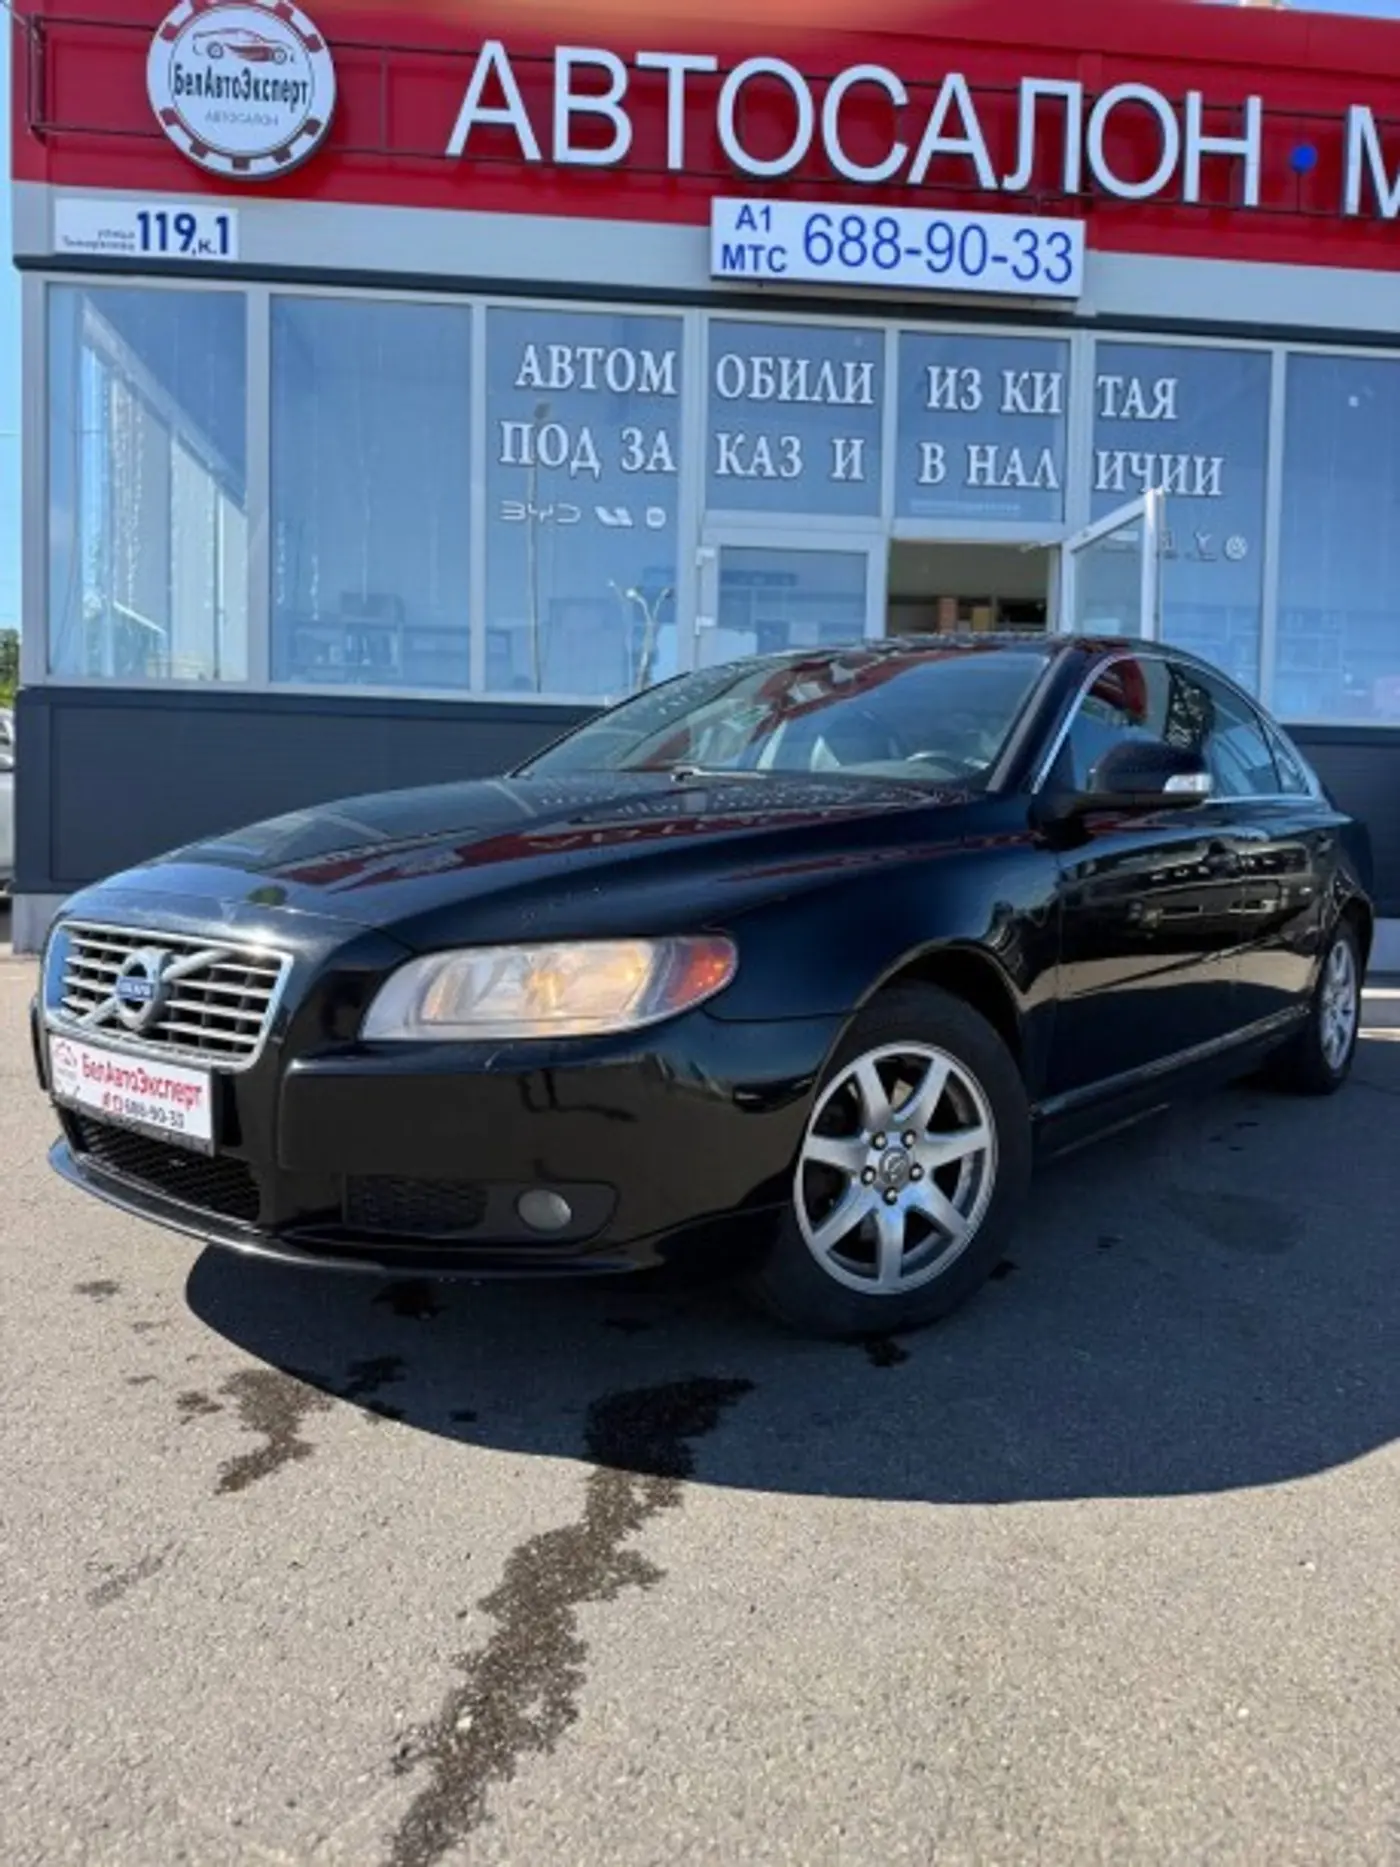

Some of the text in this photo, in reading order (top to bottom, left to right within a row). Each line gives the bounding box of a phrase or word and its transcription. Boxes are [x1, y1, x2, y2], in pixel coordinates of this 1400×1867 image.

[173, 63, 308, 113] БелАвтоЭксперт
[445, 40, 1262, 206] АВТОСАЛОН
[721, 244, 787, 273] МТС
[804, 213, 1073, 284] 688-90-33
[926, 365, 983, 411] ИЗ
[499, 420, 601, 480] ПОД
[831, 438, 866, 481] И
[918, 441, 947, 484] В
